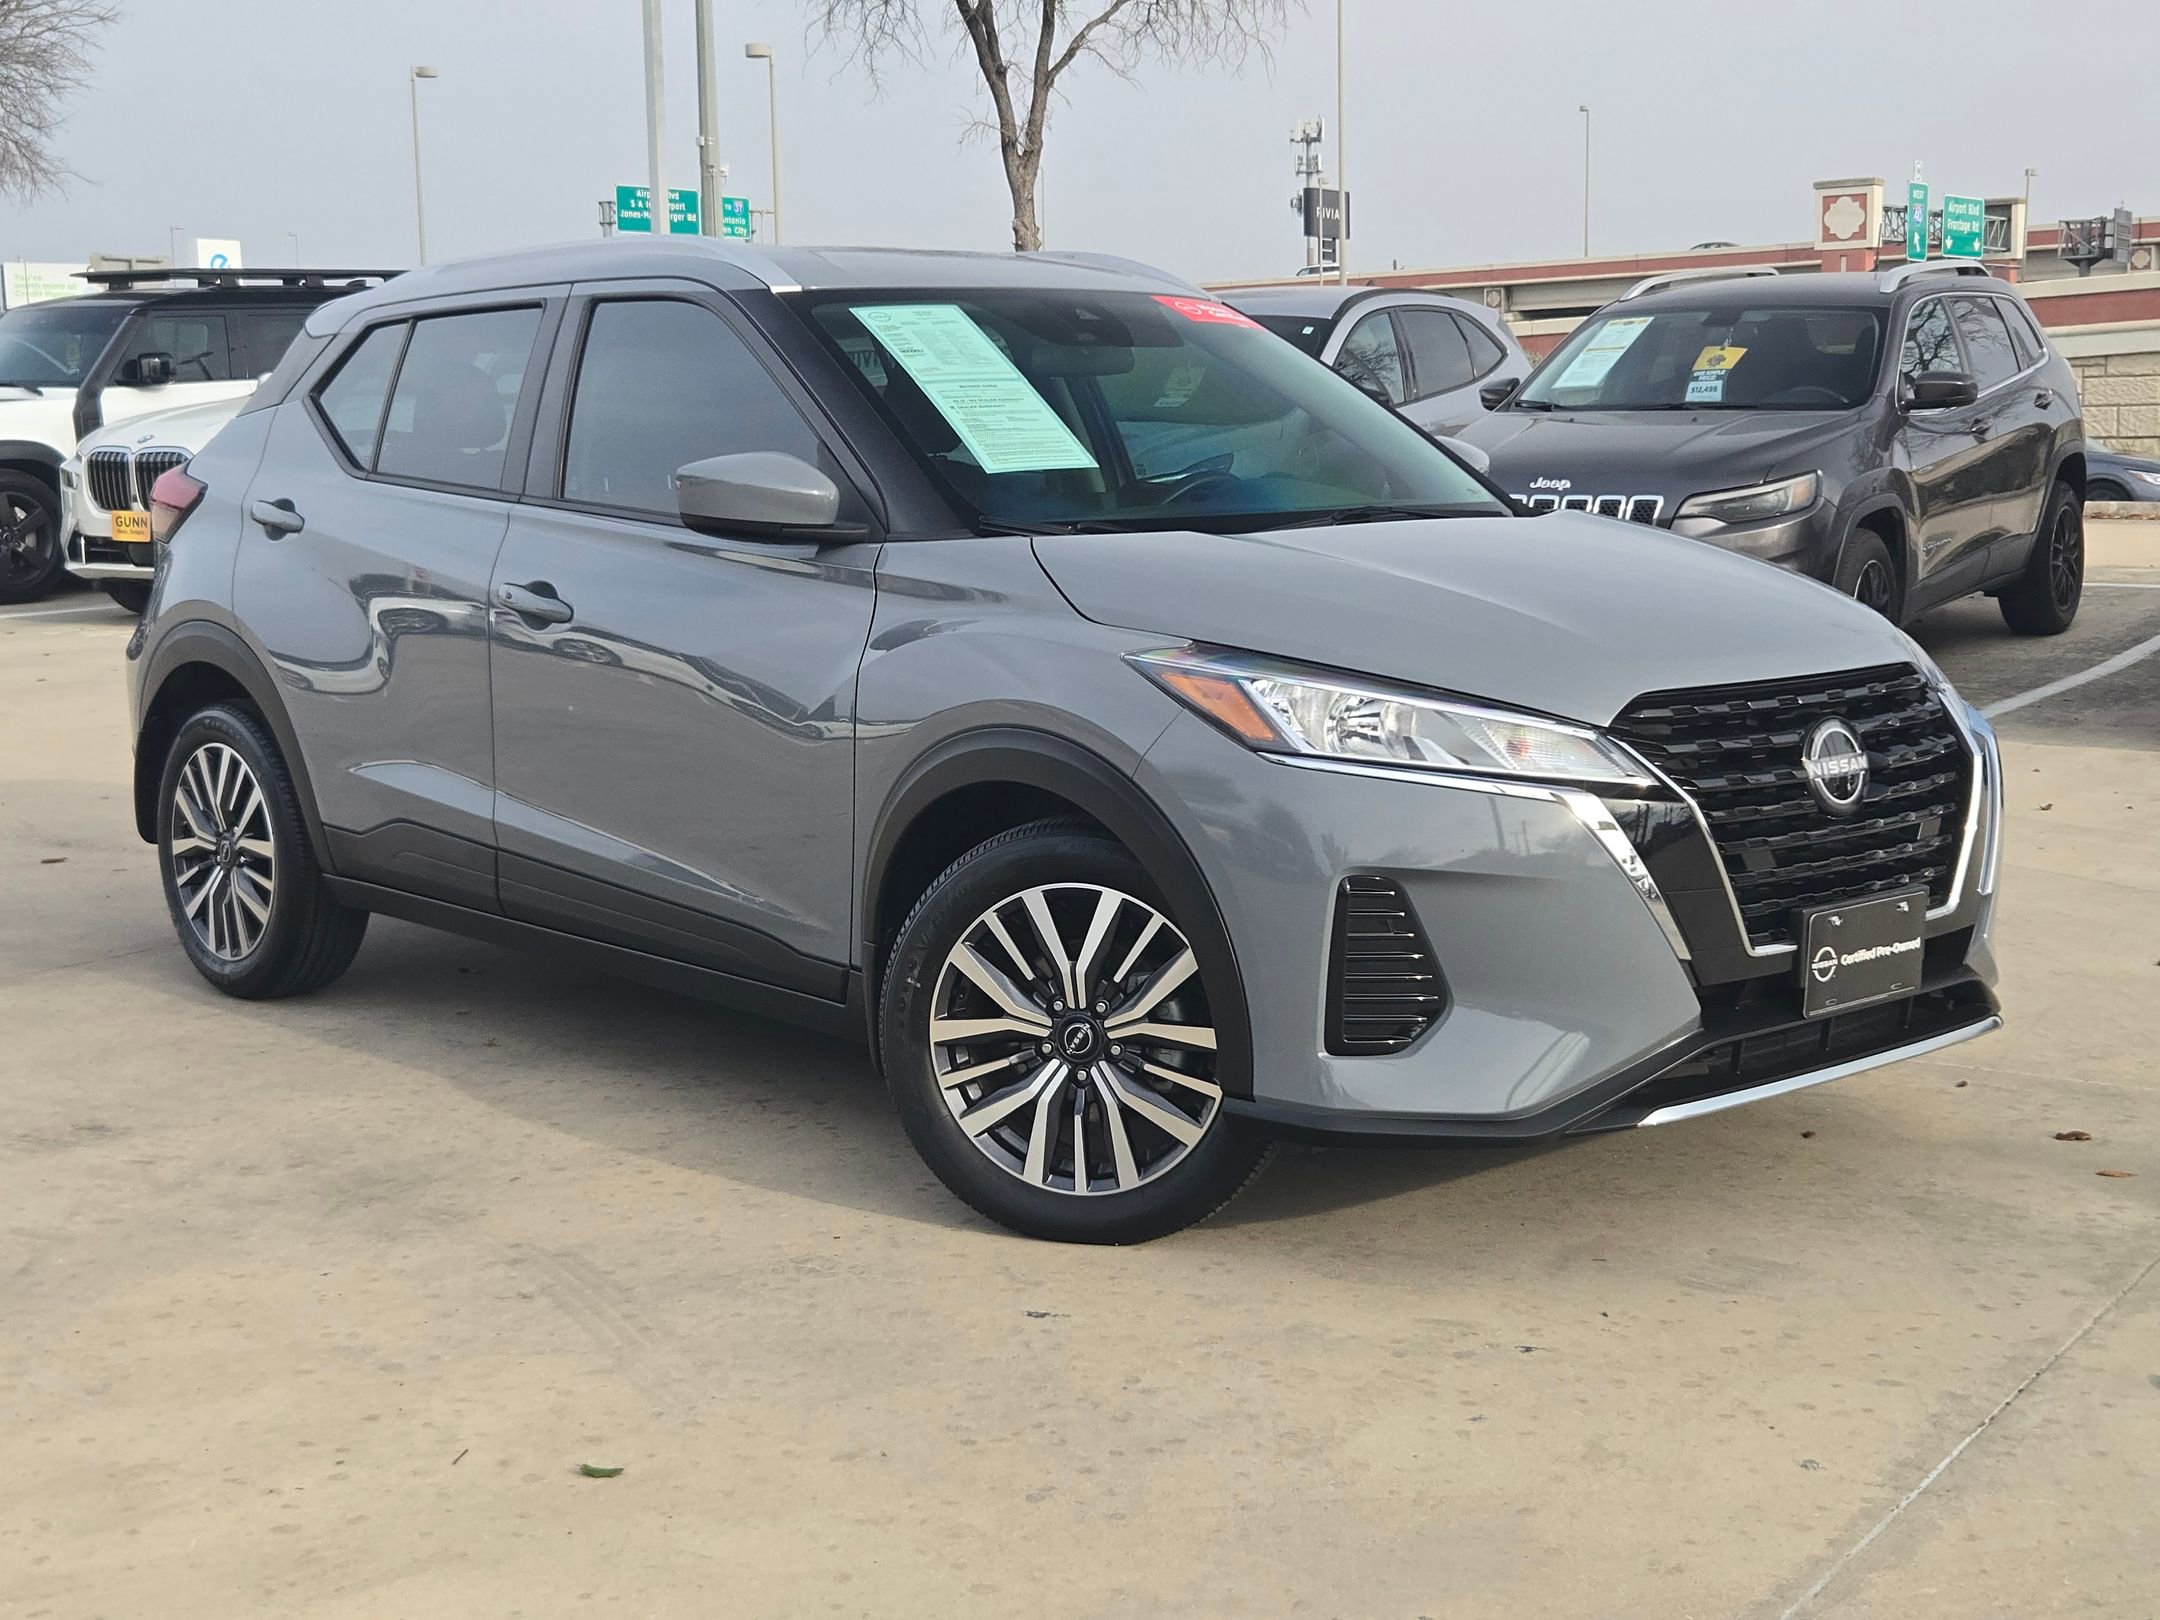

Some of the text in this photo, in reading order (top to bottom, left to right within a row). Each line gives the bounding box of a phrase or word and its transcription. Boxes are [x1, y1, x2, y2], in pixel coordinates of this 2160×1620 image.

[630, 200, 635, 208] S
[1948, 201, 1980, 215] Airport Blvd
[1316, 206, 1340, 220] RIVIA
[1947, 218, 1980, 233] Frontage Rd
[1530, 476, 1571, 491] Jeep
[115, 515, 148, 528] GUNN
[1809, 754, 1869, 779] NISSAN
[1840, 948, 1876, 966] Certified
[1876, 936, 1921, 958] Pre-Owned
[1066, 1022, 1091, 1054] NISSAN
